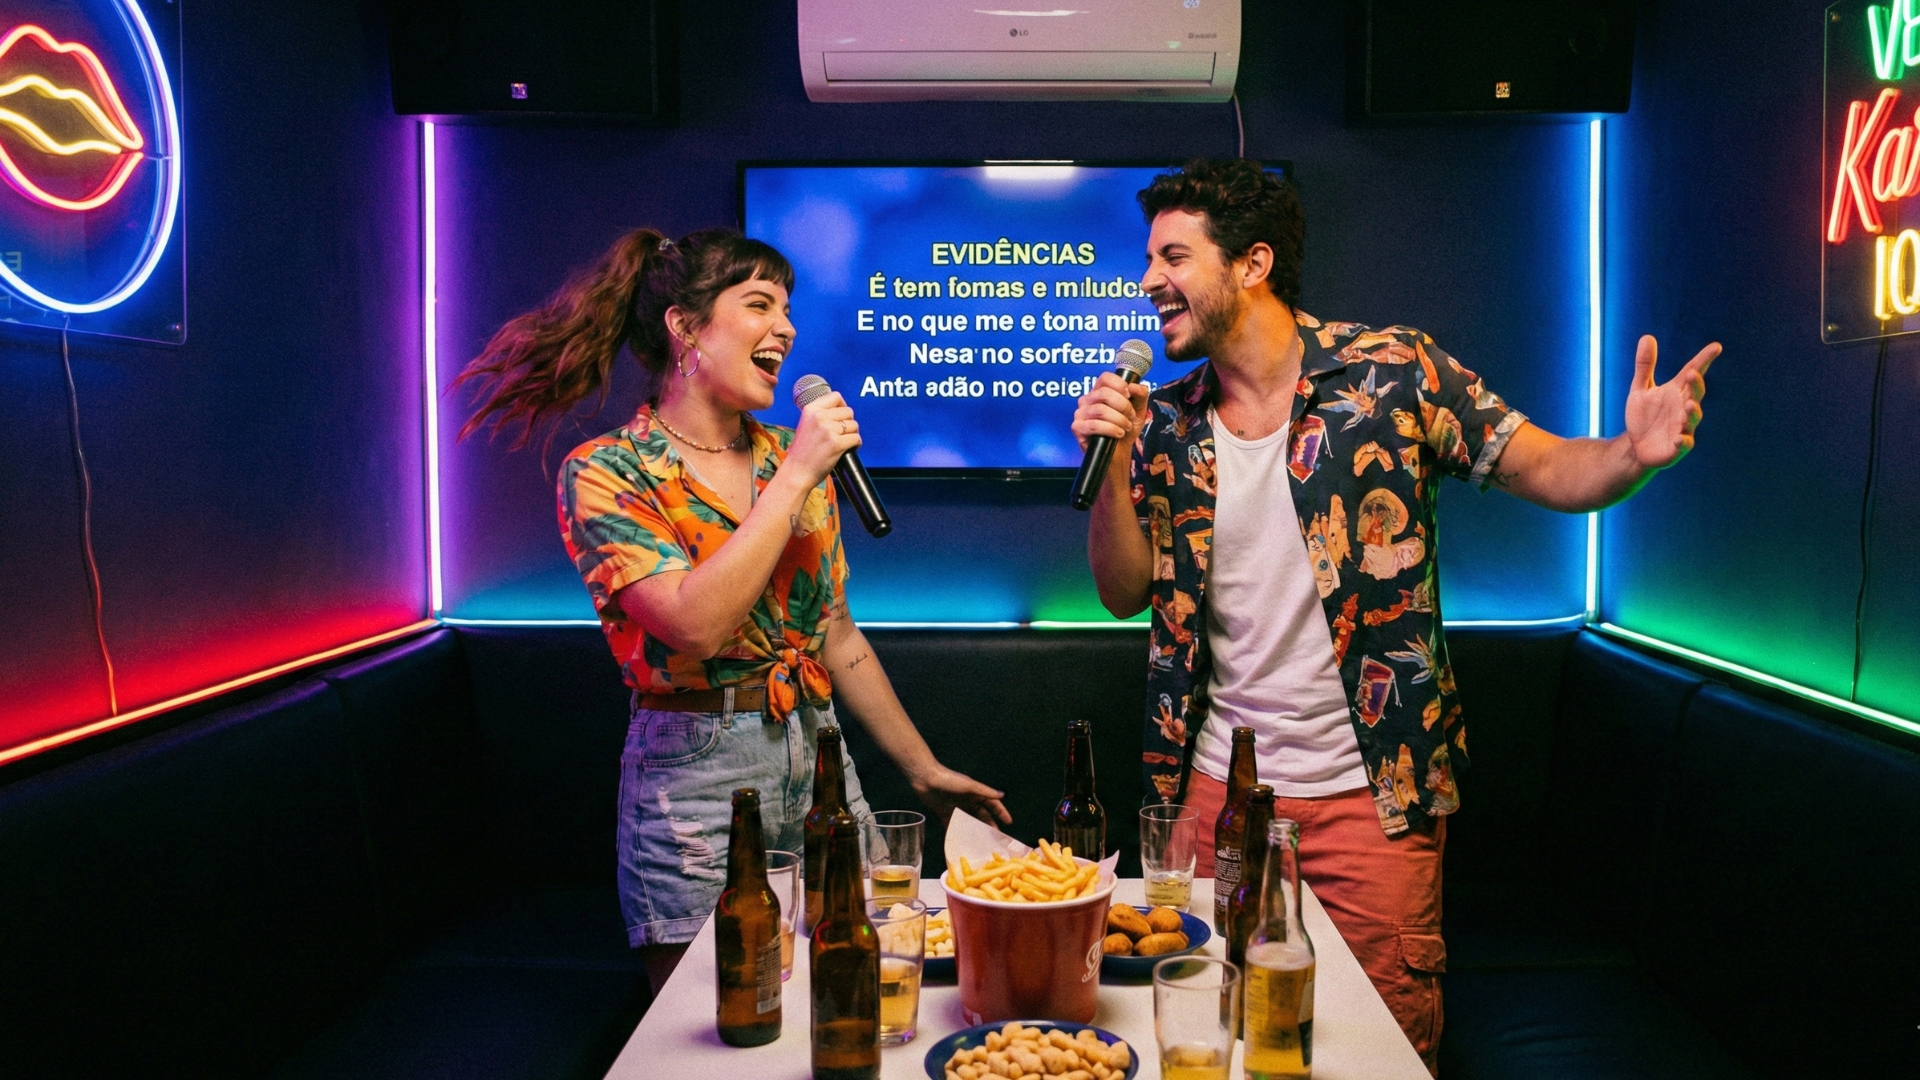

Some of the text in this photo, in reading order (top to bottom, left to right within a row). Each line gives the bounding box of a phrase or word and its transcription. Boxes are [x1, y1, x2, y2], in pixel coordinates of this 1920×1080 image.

[931, 237, 1096, 266] EVIDÊNCIAS
[868, 271, 887, 299] É
[893, 276, 941, 299] tem
[948, 276, 1025, 299] fomas
[1031, 280, 1048, 299] e
[856, 309, 1161, 337] E no que me e tona mim
[982, 347, 1015, 364] no
[859, 376, 919, 398] Anta
[925, 375, 986, 398] adão
[992, 380, 1025, 398] no
